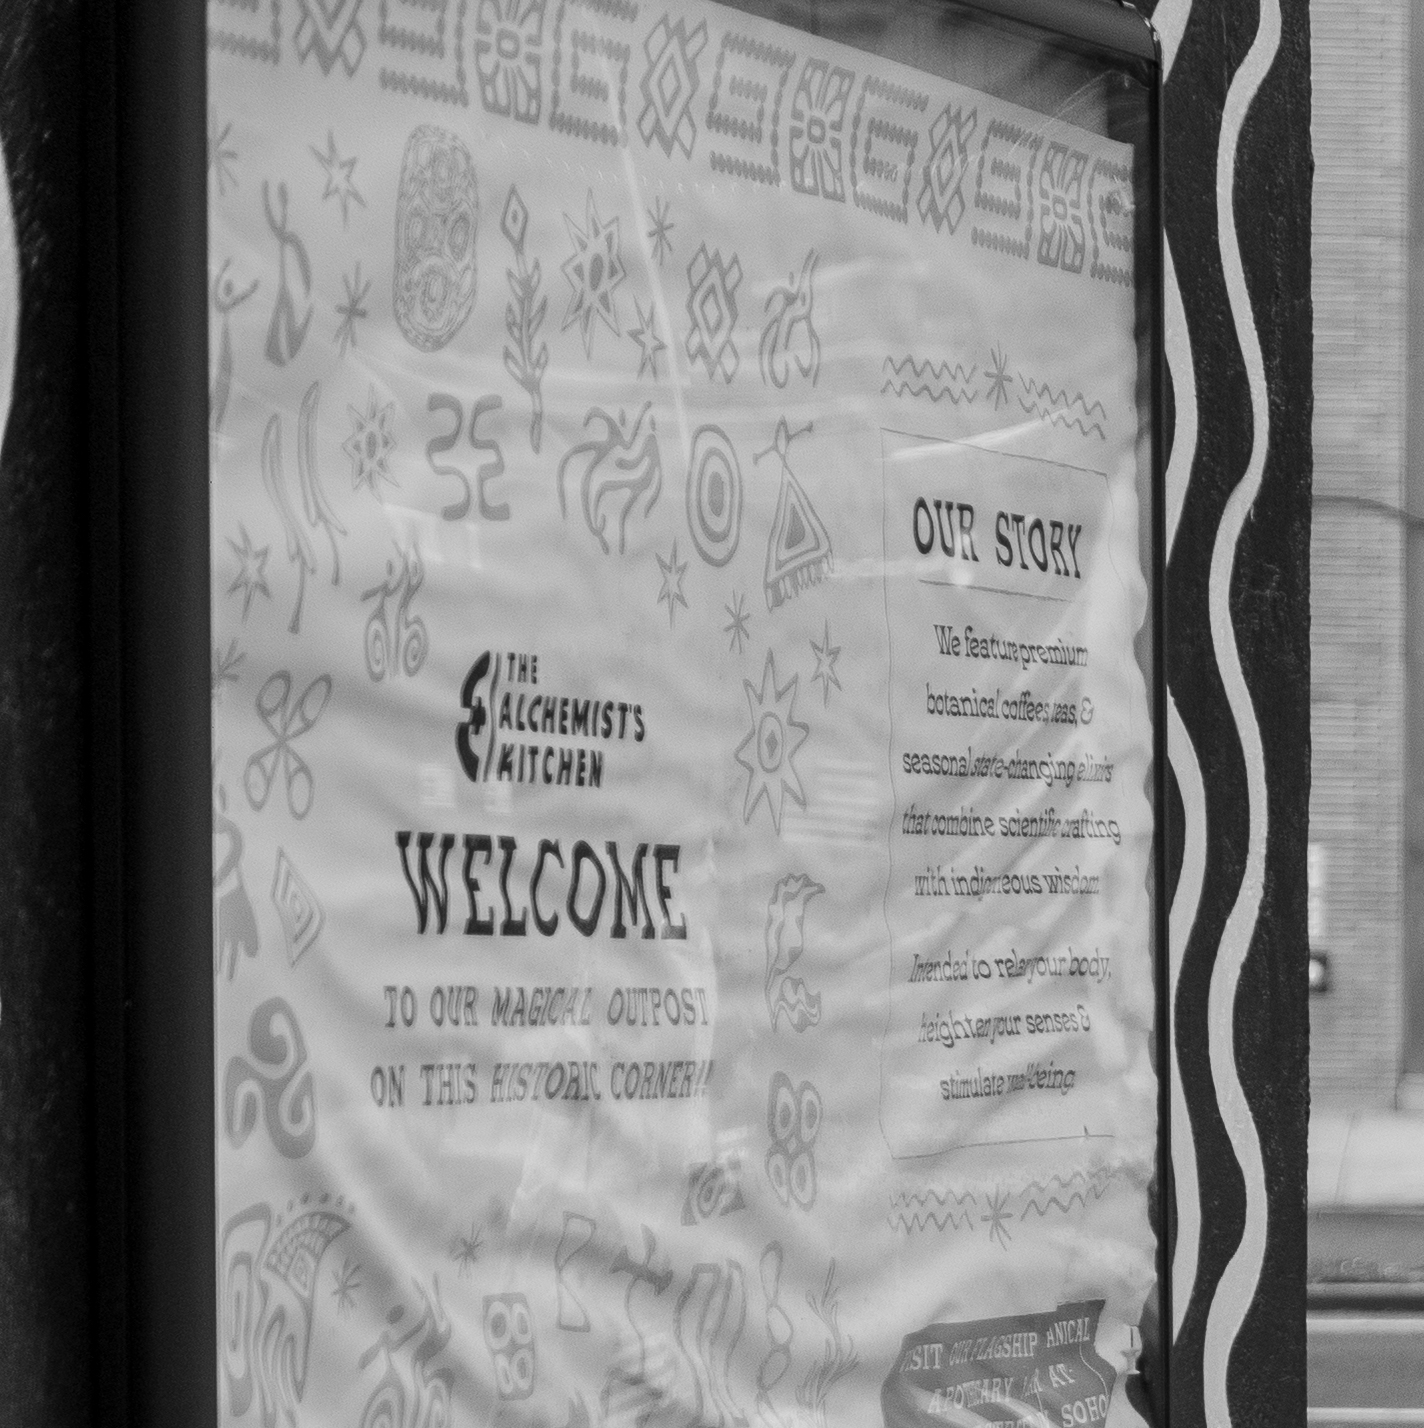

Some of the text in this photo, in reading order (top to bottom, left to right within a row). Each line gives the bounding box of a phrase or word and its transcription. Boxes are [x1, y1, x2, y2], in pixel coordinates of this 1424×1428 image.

[913, 496, 1082, 579] OUR STORY
[933, 624, 1088, 670] We feature premium
[507, 652, 537, 684] THE
[498, 691, 645, 742] ALCHEMIST'S
[926, 682, 999, 718] botanical
[1080, 696, 1094, 724] &
[496, 743, 603, 788] KITCHEN
[902, 746, 972, 778] seasonal
[902, 802, 931, 835] that
[931, 806, 995, 836] combine
[394, 830, 688, 940] WELCOME
[915, 865, 951, 896] with
[908, 949, 968, 983] Intended
[972, 955, 991, 980] to
[1068, 947, 1111, 984] body,
[384, 985, 708, 1028] TO OUR MAGICAL OUTPOST
[1026, 1012, 1079, 1034] senses
[1077, 1004, 1091, 1031] &
[370, 1064, 405, 1107] ON
[420, 1062, 478, 1106] THIS
[490, 1061, 601, 1102] HISTORIC
[940, 1067, 1004, 1100] stimulate
[1061, 1394, 1107, 1428] SOHO
